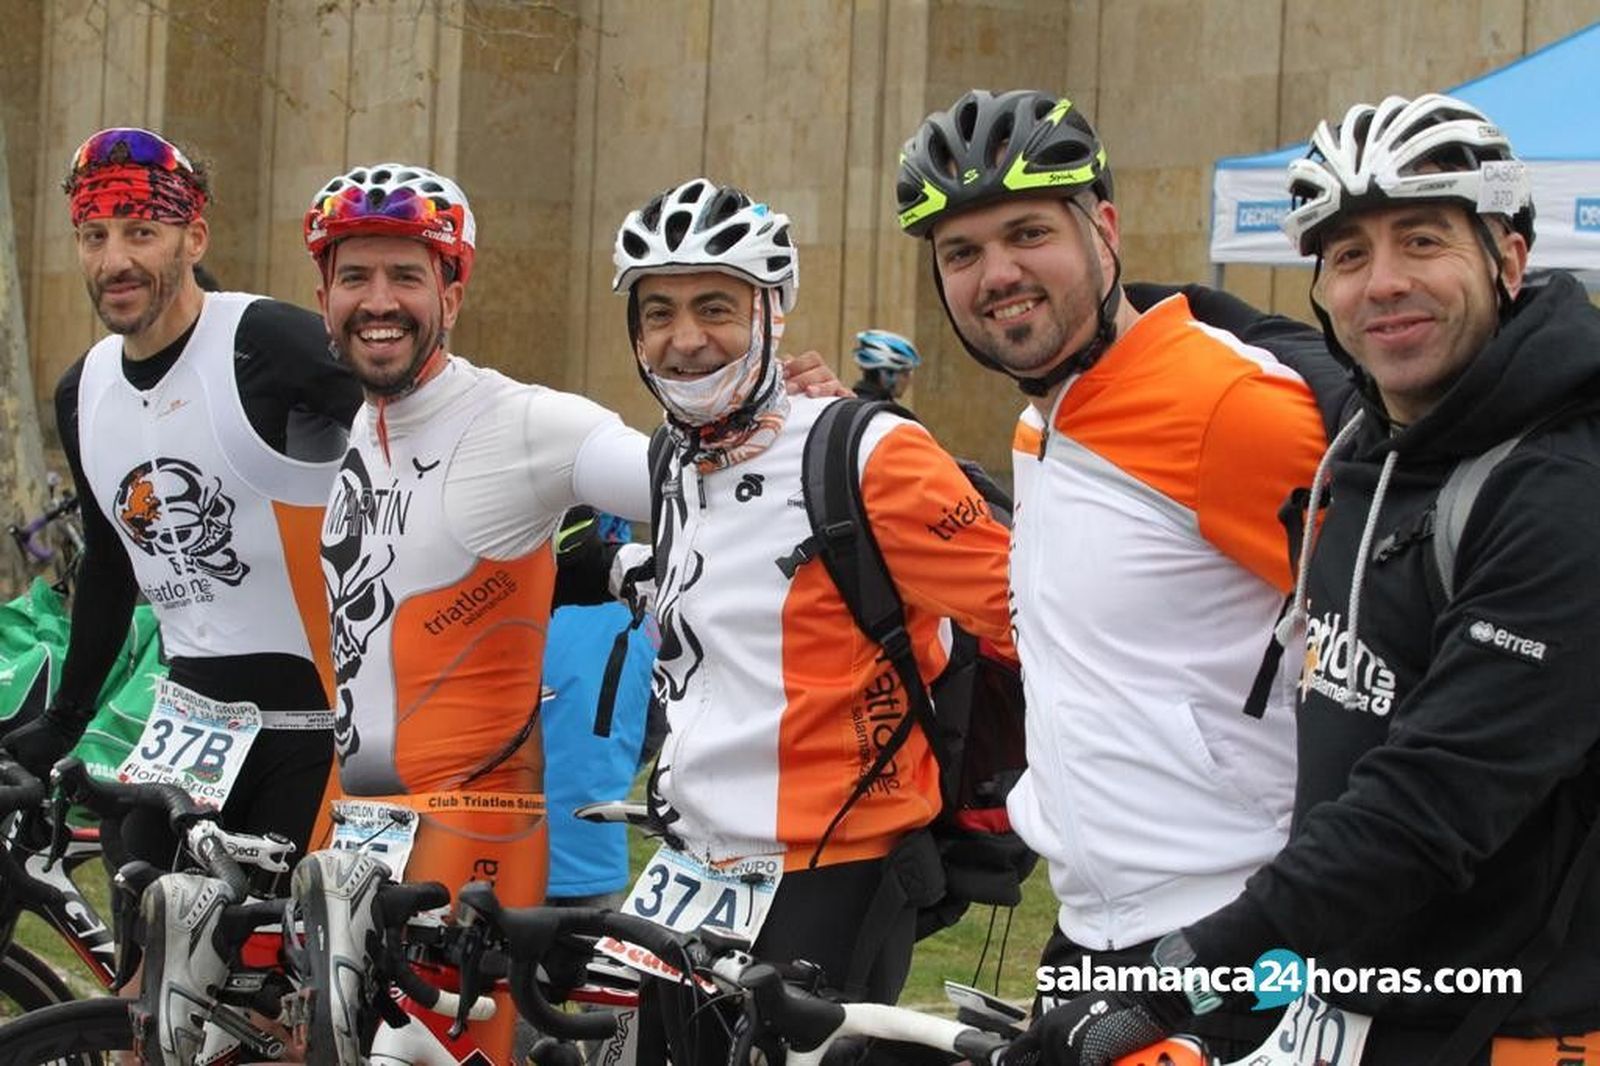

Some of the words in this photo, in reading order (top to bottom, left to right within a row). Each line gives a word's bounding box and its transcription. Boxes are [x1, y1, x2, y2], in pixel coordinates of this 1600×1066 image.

[424, 577, 502, 635] triatlon
[1494, 628, 1547, 659] errea
[141, 718, 234, 773] 37B
[428, 796, 459, 808] Club
[462, 796, 515, 809] Triatlon
